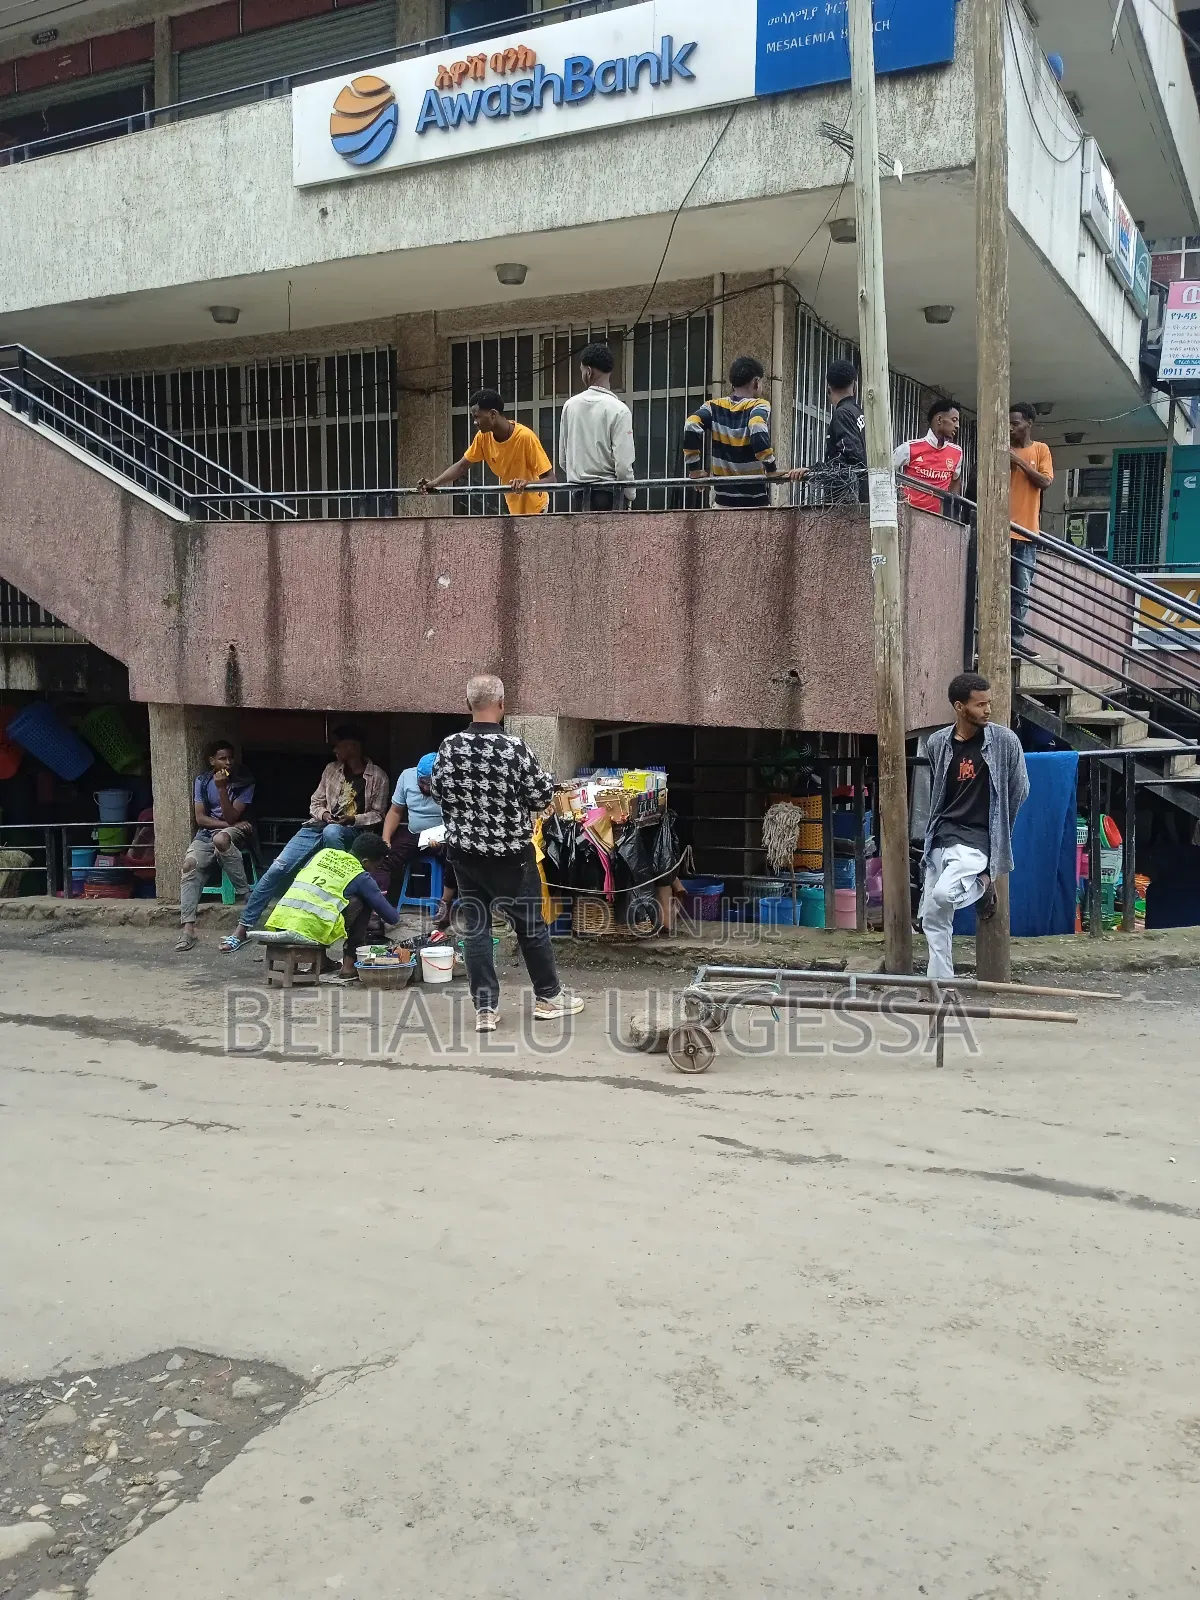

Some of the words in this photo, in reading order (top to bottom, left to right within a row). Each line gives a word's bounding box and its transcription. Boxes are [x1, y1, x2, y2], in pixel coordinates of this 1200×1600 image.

[766, 30, 835, 54] MESALEMIA
[841, 19, 890, 39] BCH
[434, 52, 488, 90] አዋሽ
[490, 44, 538, 76] ባንክ
[1163, 368, 1182, 376] 0911
[1186, 368, 1196, 376] 57
[311, 875, 327, 888] 12
